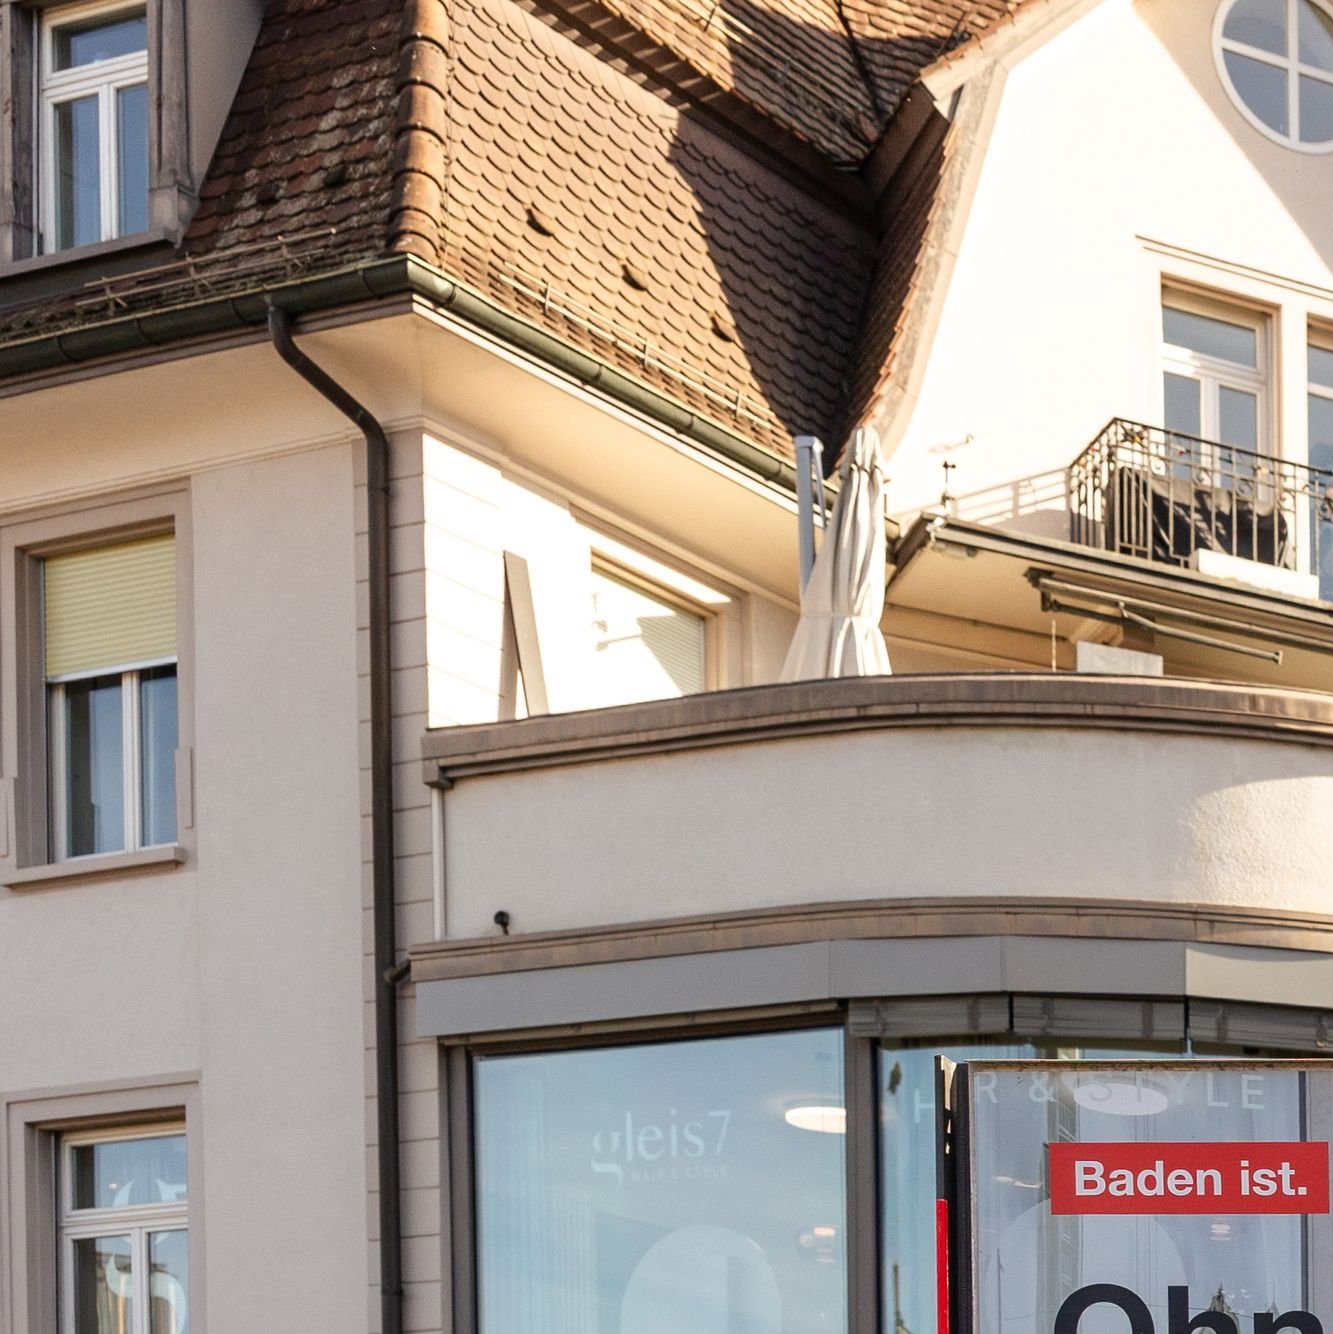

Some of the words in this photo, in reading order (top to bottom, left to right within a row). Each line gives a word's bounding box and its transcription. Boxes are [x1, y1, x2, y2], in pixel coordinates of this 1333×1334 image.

[591, 1107, 731, 1187] gleis7
[1074, 1160, 1222, 1197] Baden
[1240, 1160, 1308, 1196] ist.
